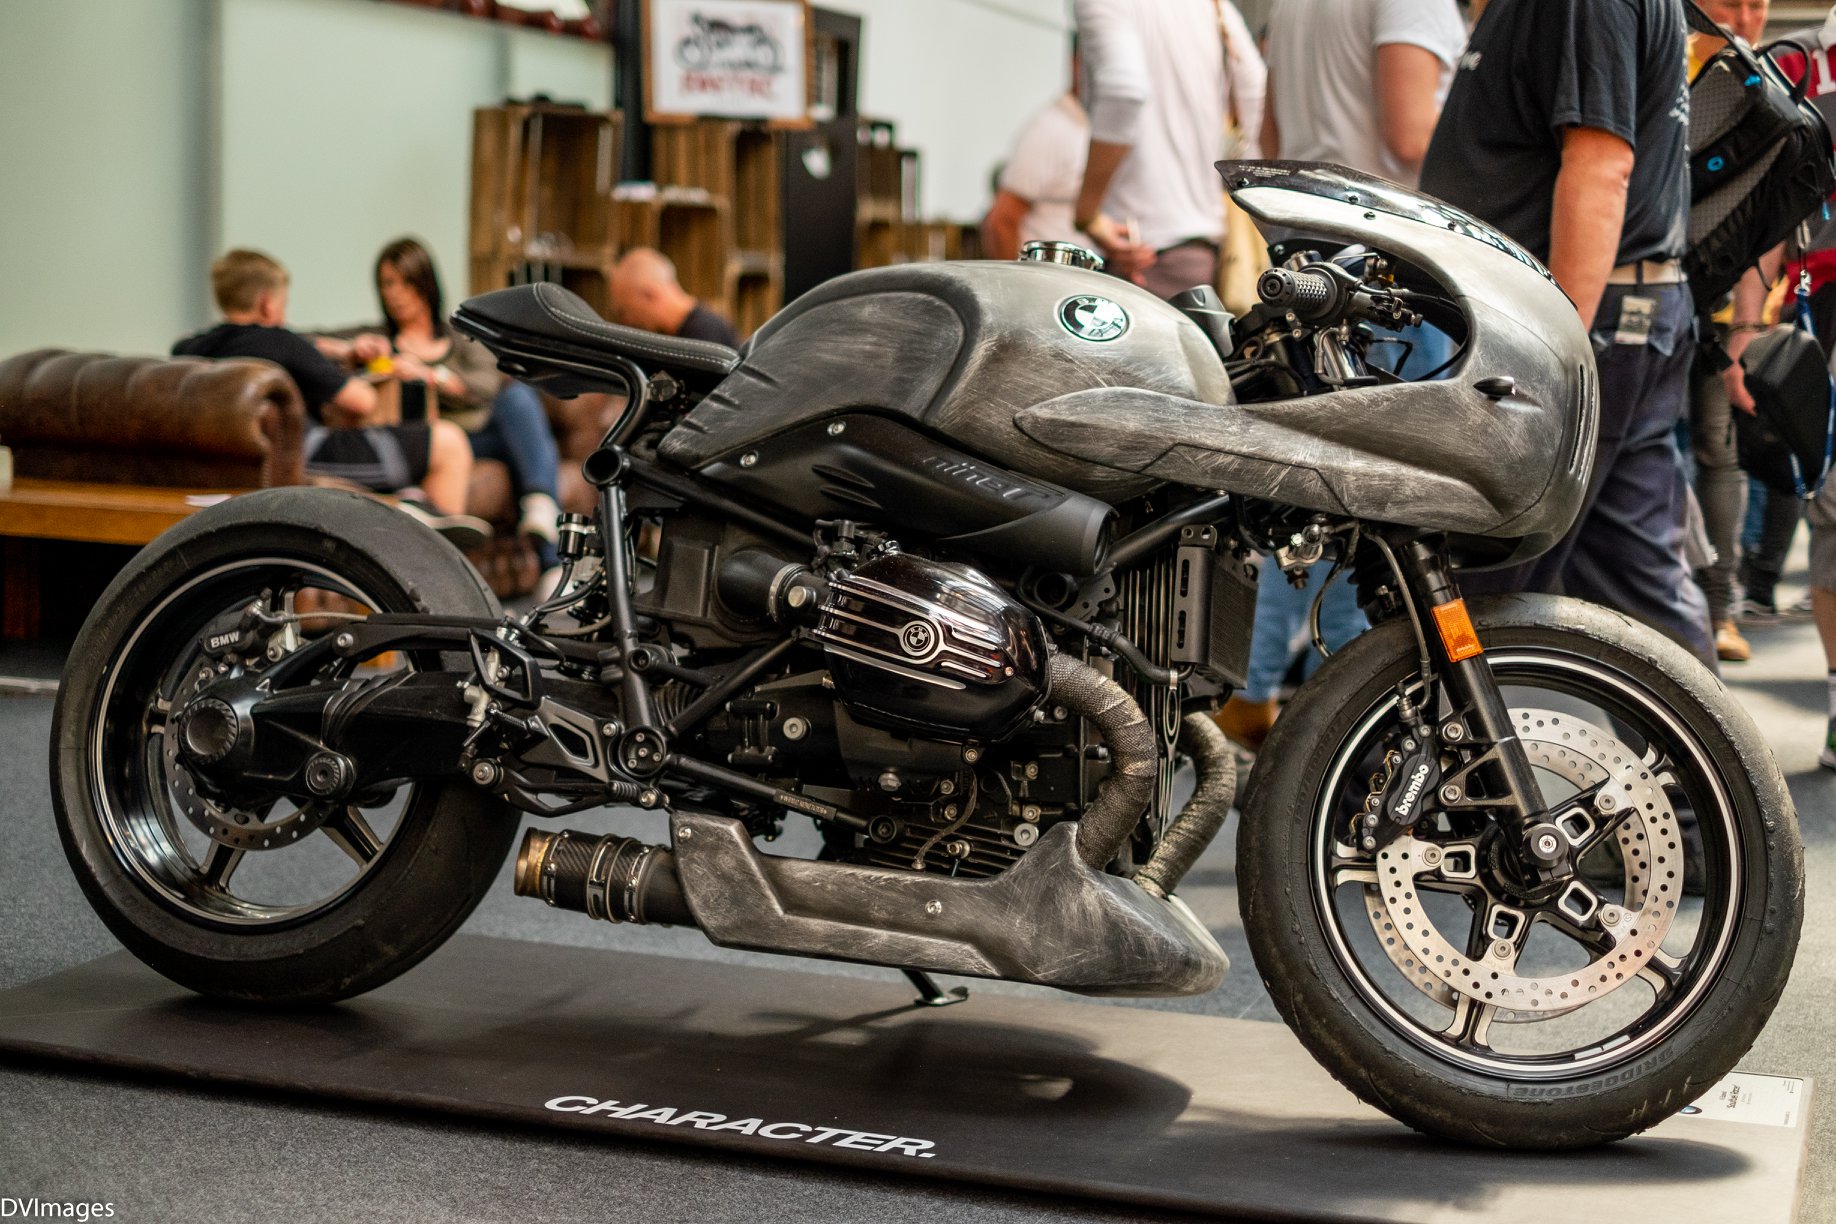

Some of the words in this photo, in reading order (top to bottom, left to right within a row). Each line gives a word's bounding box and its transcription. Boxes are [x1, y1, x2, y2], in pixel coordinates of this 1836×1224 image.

[211, 631, 239, 648] BMW
[1395, 764, 1429, 816] brembo
[544, 1094, 938, 1159] CHARACTER.
